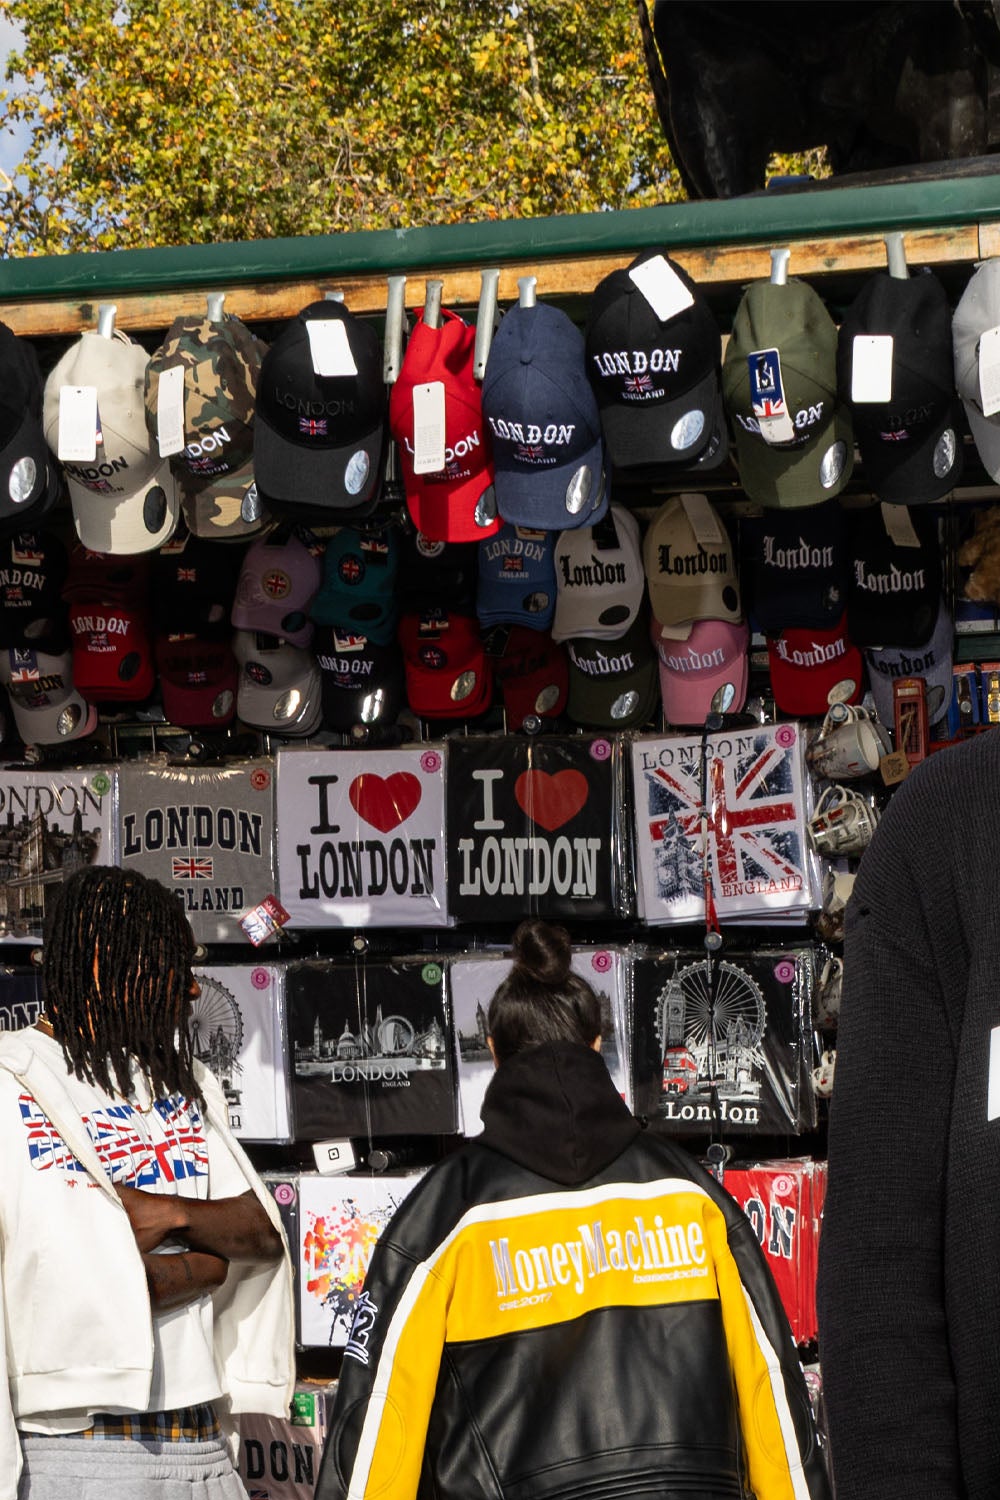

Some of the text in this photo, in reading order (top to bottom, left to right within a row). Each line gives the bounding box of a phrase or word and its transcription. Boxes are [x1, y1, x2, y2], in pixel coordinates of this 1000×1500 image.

[593, 349, 682, 377] LONDON
[274, 387, 354, 417] LONDON
[622, 388, 665, 401] ENGLAND
[488, 417, 576, 445] LONDON
[736, 402, 824, 434] LOON
[63, 457, 129, 480] ONDON
[513, 453, 557, 464] ENGLAND
[484, 540, 547, 562] LONDON
[658, 544, 727, 576] London
[763, 536, 833, 569] London
[0, 569, 46, 590] NDON
[560, 554, 626, 587] London
[854, 560, 925, 594] London
[72, 616, 131, 636] LONDON
[317, 655, 374, 676] LONDON
[569, 646, 634, 675] London
[658, 641, 725, 672] London
[776, 637, 846, 667] London
[869, 651, 935, 676] London
[427, 757, 435, 767] S
[641, 736, 753, 771] LONDON
[0, 785, 103, 816] NDON
[308, 774, 341, 835] I
[472, 769, 505, 830] I
[123, 804, 263, 858] LONDON
[297, 838, 436, 899] LONDON
[458, 836, 601, 897] LONDON
[177, 887, 244, 911] GLAND
[721, 874, 802, 897] ENGLAND
[428, 970, 436, 979] M
[331, 1066, 408, 1083] LONDON
[382, 1080, 410, 1088] ENGLAND
